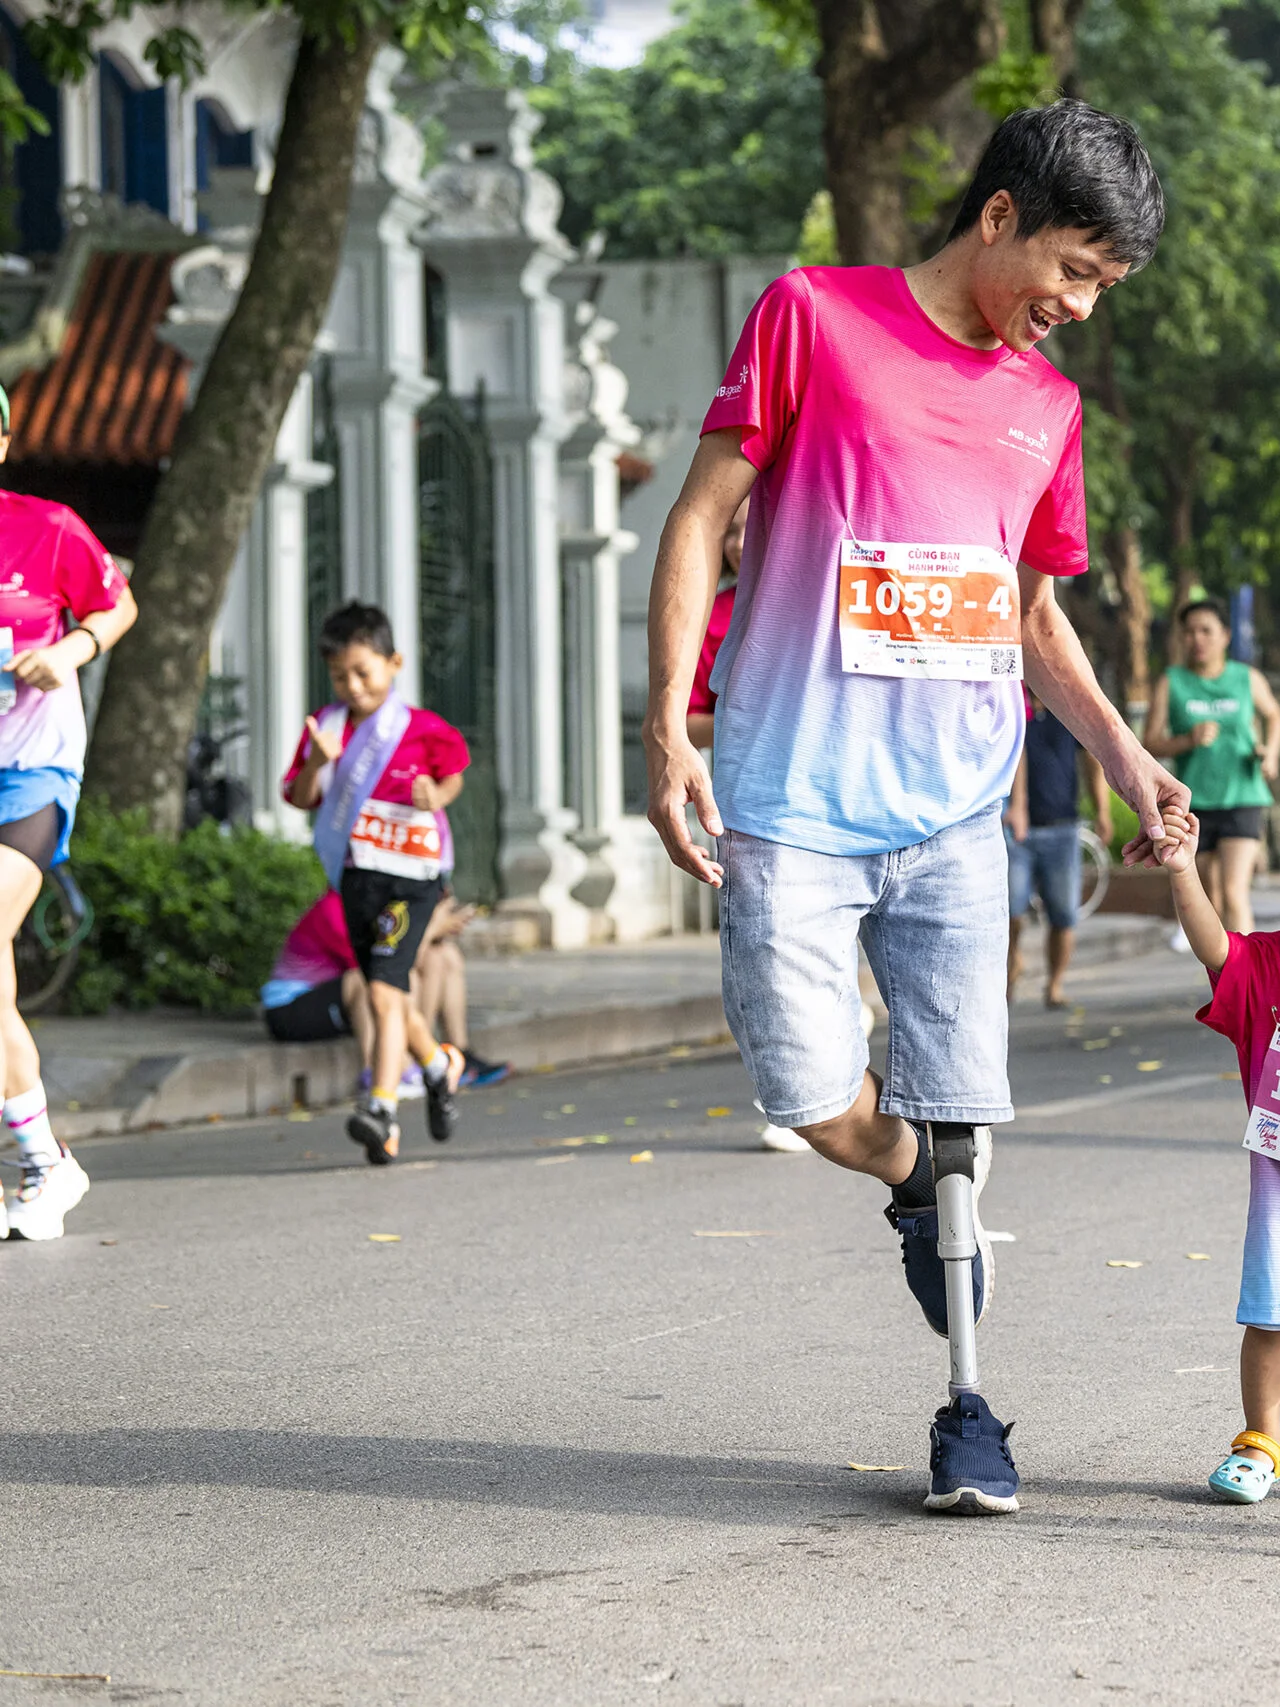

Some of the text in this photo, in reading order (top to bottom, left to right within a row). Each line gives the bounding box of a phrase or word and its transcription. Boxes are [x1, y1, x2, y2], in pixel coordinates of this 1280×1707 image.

[850, 554, 874, 562] EKIDEN
[908, 548, 960, 563] CÙNG BẠN
[908, 563, 934, 574] HẠNH
[848, 579, 953, 618] 1059
[987, 585, 1012, 620] 4
